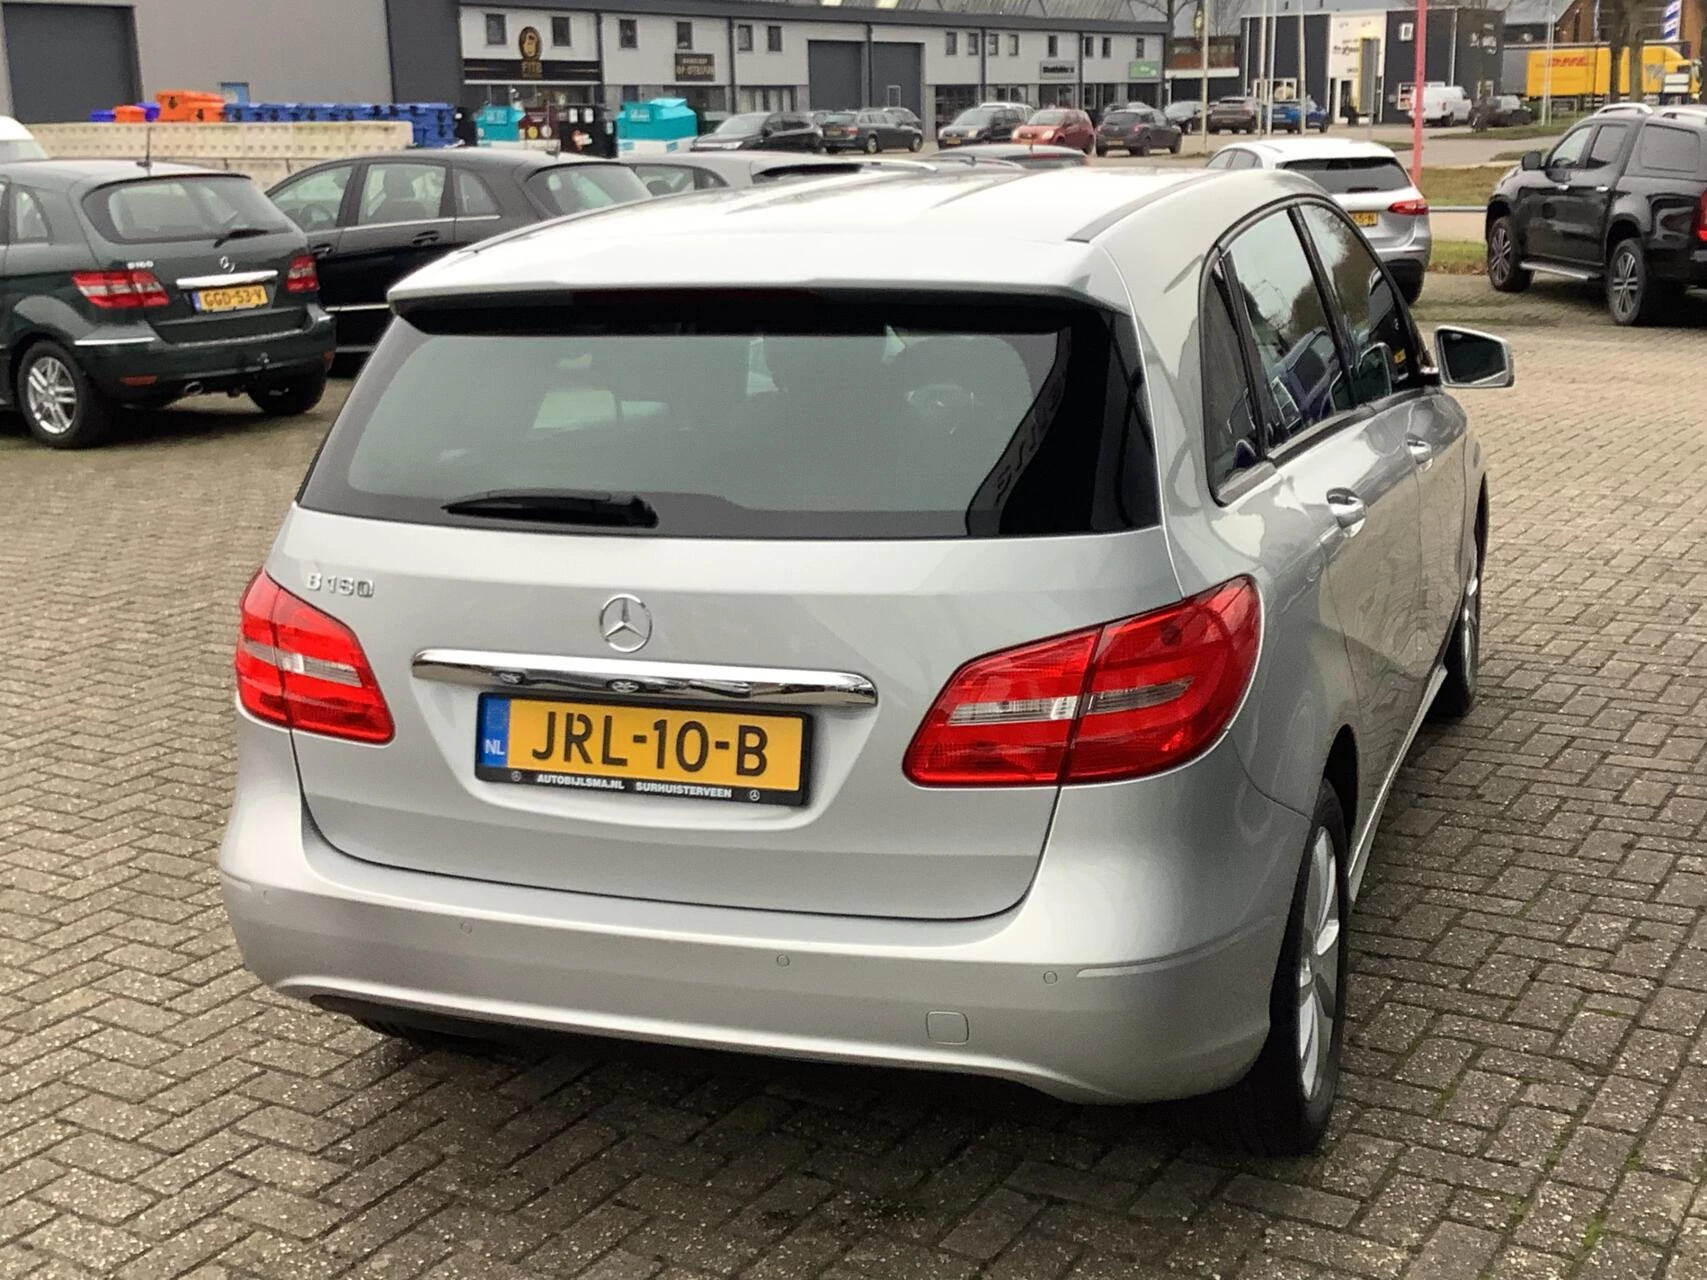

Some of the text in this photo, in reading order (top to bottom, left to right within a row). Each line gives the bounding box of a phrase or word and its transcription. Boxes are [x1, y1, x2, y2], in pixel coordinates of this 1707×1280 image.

[484, 739, 506, 756] NL
[531, 711, 769, 777] JRL-10-B
[536, 773, 733, 799] AUTOBIJLSMA.NL SURHUISTERVEEN
